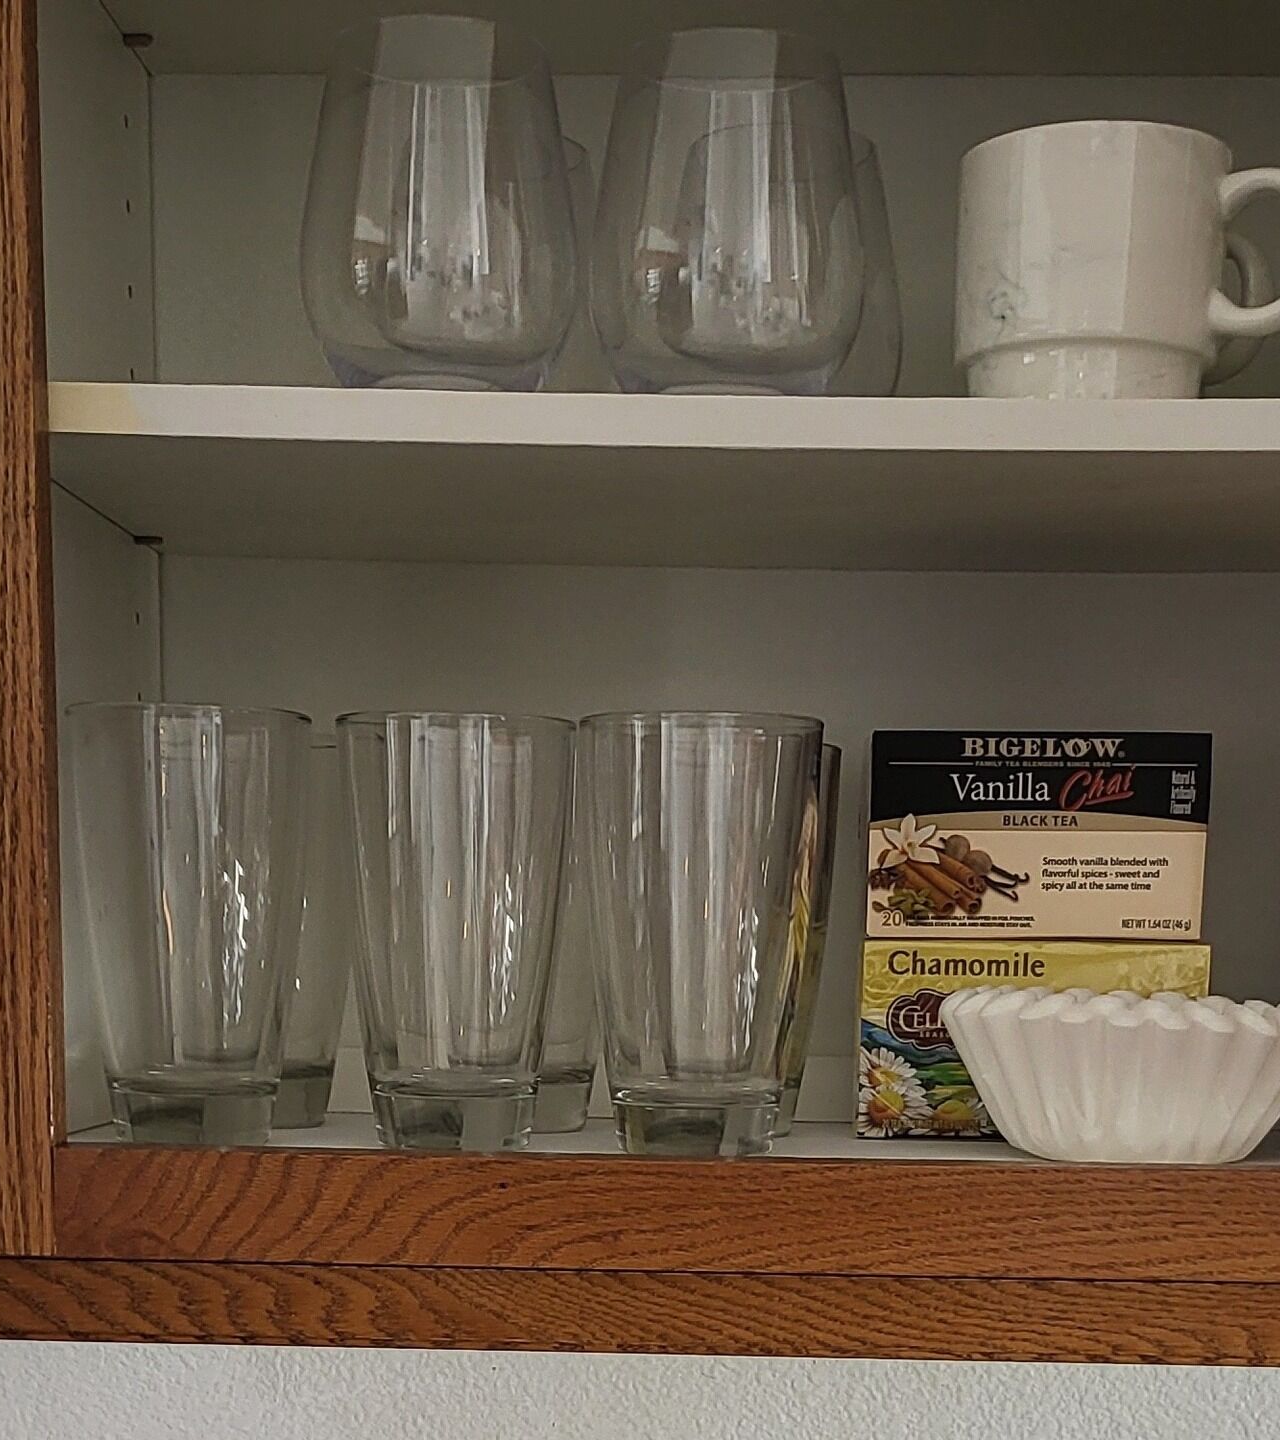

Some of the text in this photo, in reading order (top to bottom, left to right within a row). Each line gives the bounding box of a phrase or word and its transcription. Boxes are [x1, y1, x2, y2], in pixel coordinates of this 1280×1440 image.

[961, 737, 1123, 758] BIGELOW
[950, 772, 1051, 802] Vanilla
[1058, 764, 1137, 811] Chai
[1003, 815, 1078, 827] BLACK TEA
[1042, 857, 1168, 867] Smooth vanilla blended with
[1042, 869, 1079, 878] flavorful
[1081, 869, 1108, 880] spices
[1114, 870, 1141, 878] sweet
[1142, 869, 1159, 878] and
[1041, 881, 1064, 891] spicy
[1066, 881, 1076, 890] all
[1078, 882, 1087, 890] at
[1089, 881, 1104, 890] the
[1131, 881, 1151, 890] time
[881, 911, 902, 926] 20
[888, 950, 1045, 977] Chamomile
